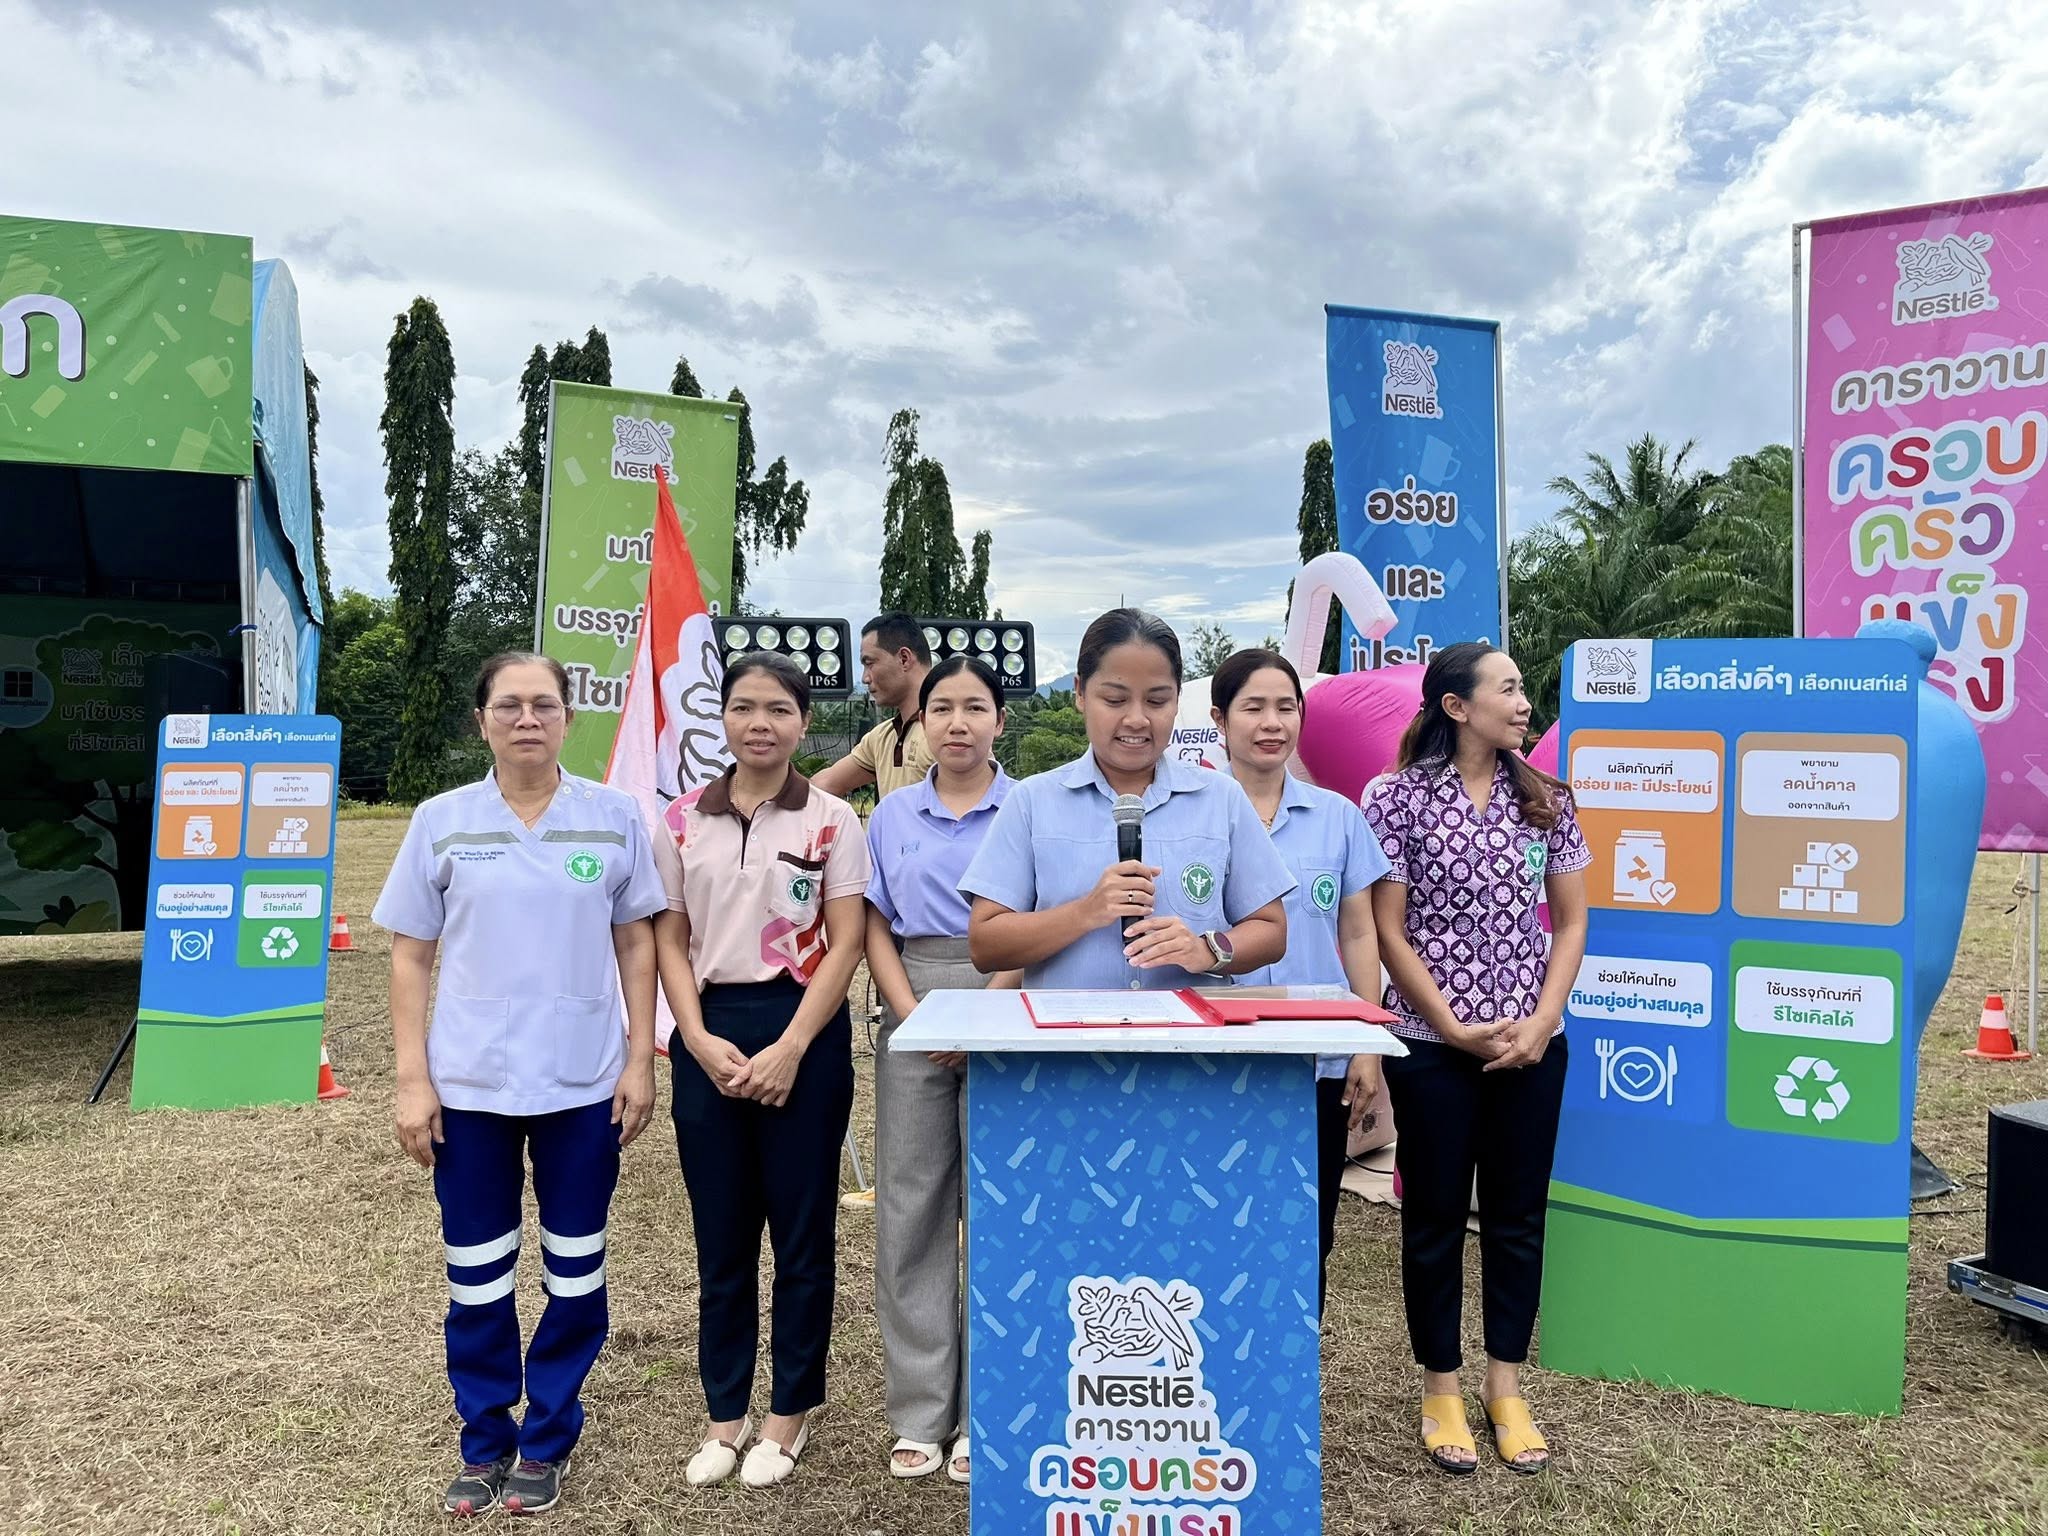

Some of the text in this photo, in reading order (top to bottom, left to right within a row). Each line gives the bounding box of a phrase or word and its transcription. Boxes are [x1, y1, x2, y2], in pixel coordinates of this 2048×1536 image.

[1837, 349, 2046, 409] คาราวาน
[1837, 420, 2037, 496] ครอบ
[1367, 478, 1455, 523] อร่อย
[1858, 490, 2005, 567] ครัว
[608, 531, 654, 561] มาใ
[1386, 567, 1442, 598] และ
[809, 675, 838, 686] IP65
[1001, 675, 1022, 686] P65
[1655, 659, 1907, 695] เลือกสิ่งดีๆ เลือกเนสท์เล่
[211, 725, 282, 744] เลือกสิ่งดีๆ
[1607, 760, 1673, 775] ผลิตภัณฑ์ที่
[1800, 759, 1839, 768] พยายาม
[1573, 776, 1712, 795] อร่อย และ มีประโยชน์
[1783, 772, 1856, 792] ลดน้ำตาล
[1788, 801, 1850, 812] ออกจากสินค้า
[1597, 970, 1676, 988] ช่วยให้คนไทย
[1766, 981, 1863, 1003] ใช้บรรจุภัณฑ์ที่
[1571, 990, 1704, 1020] กินอยู่อย่างสมดุล
[1773, 1005, 1854, 1028] รีไซเคิลได้
[1075, 1417, 1211, 1443] คาราวาน
[1039, 1446, 1247, 1492] ครอบครัว
